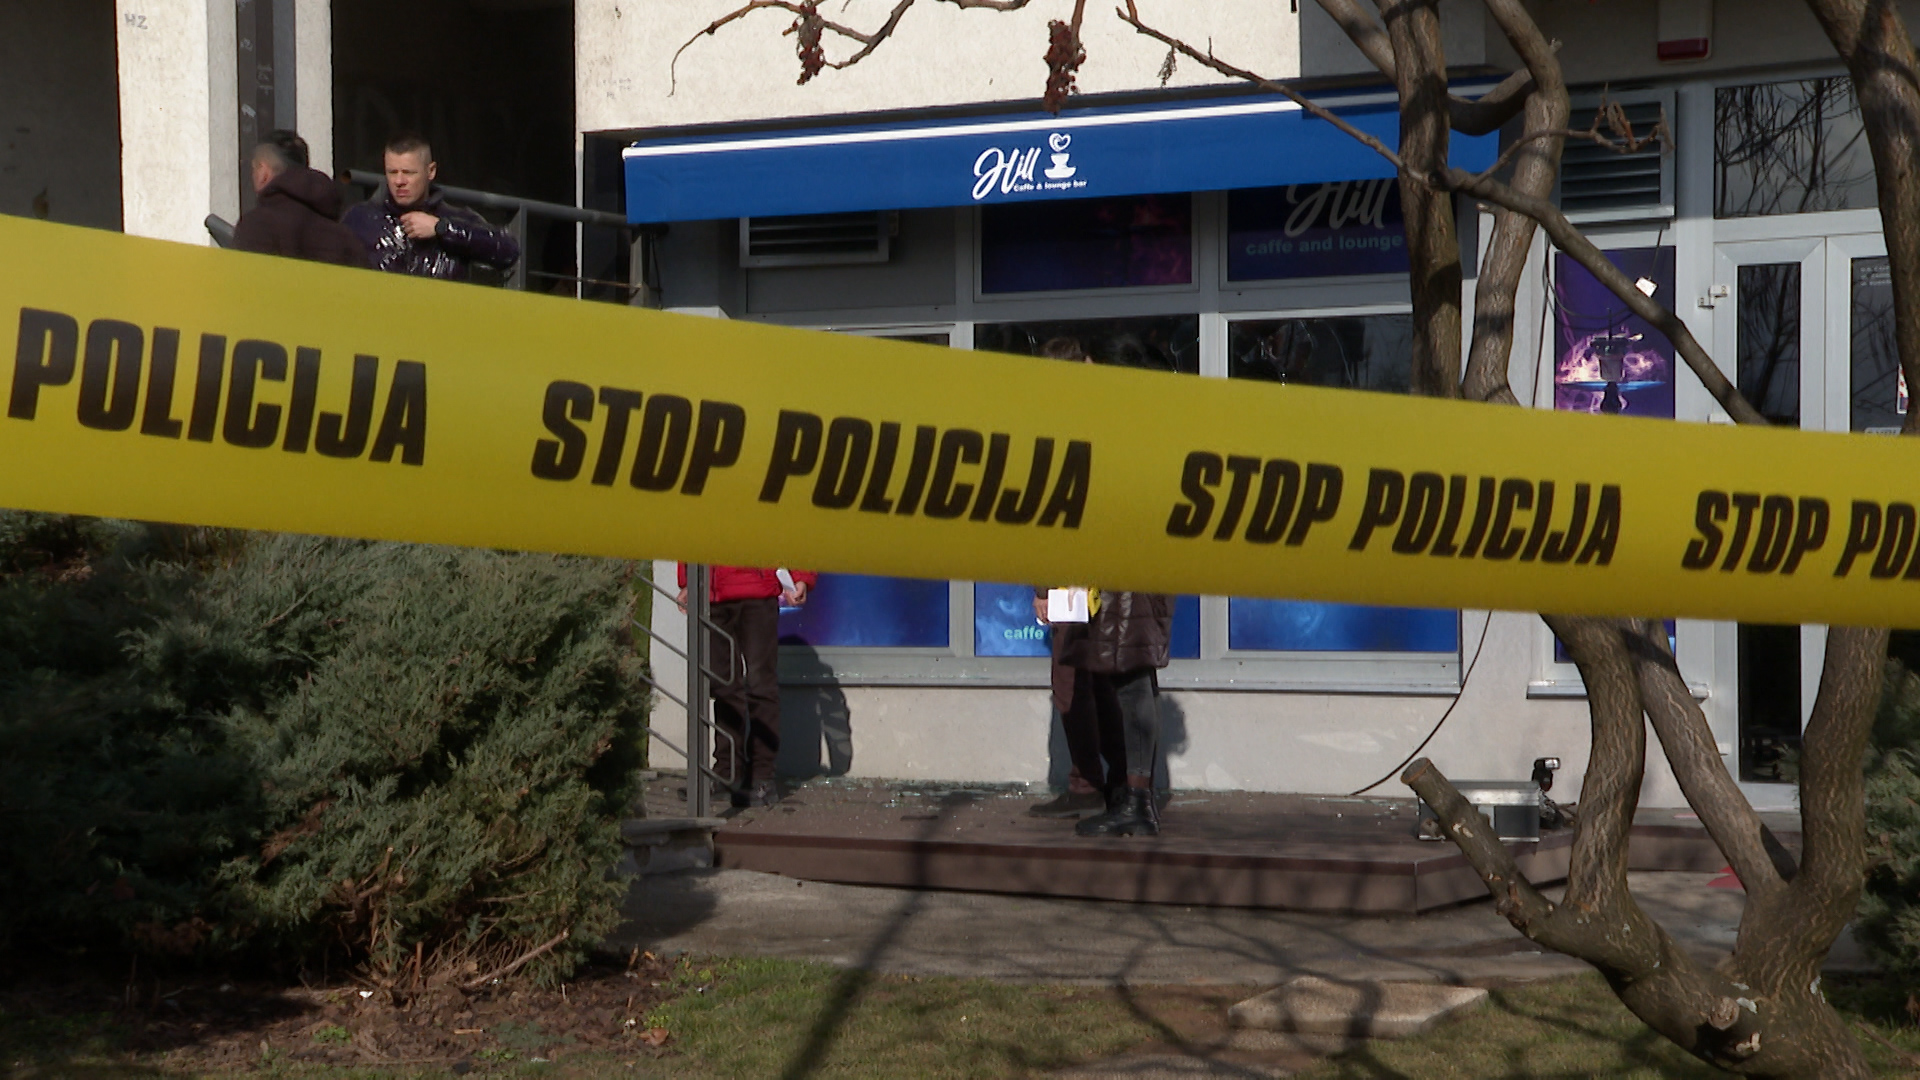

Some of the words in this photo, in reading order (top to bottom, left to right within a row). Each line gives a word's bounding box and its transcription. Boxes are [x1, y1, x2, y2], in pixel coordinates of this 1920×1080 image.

[971, 147, 1041, 200] Hill
[1045, 181, 1072, 190] lounge
[1073, 179, 1087, 188] bar
[1284, 178, 1393, 238] Hill
[1246, 240, 1293, 255] caffe
[1299, 236, 1333, 252] and
[1339, 235, 1404, 251] lounge
[8, 308, 427, 466] POLICIJA
[531, 381, 745, 496] STOP
[759, 410, 1091, 529] POLICIJA
[1166, 452, 1343, 547] STOP
[1348, 468, 1621, 566] POLICIJA
[1681, 490, 1829, 575] STOP
[1003, 625, 1044, 640] caffe
